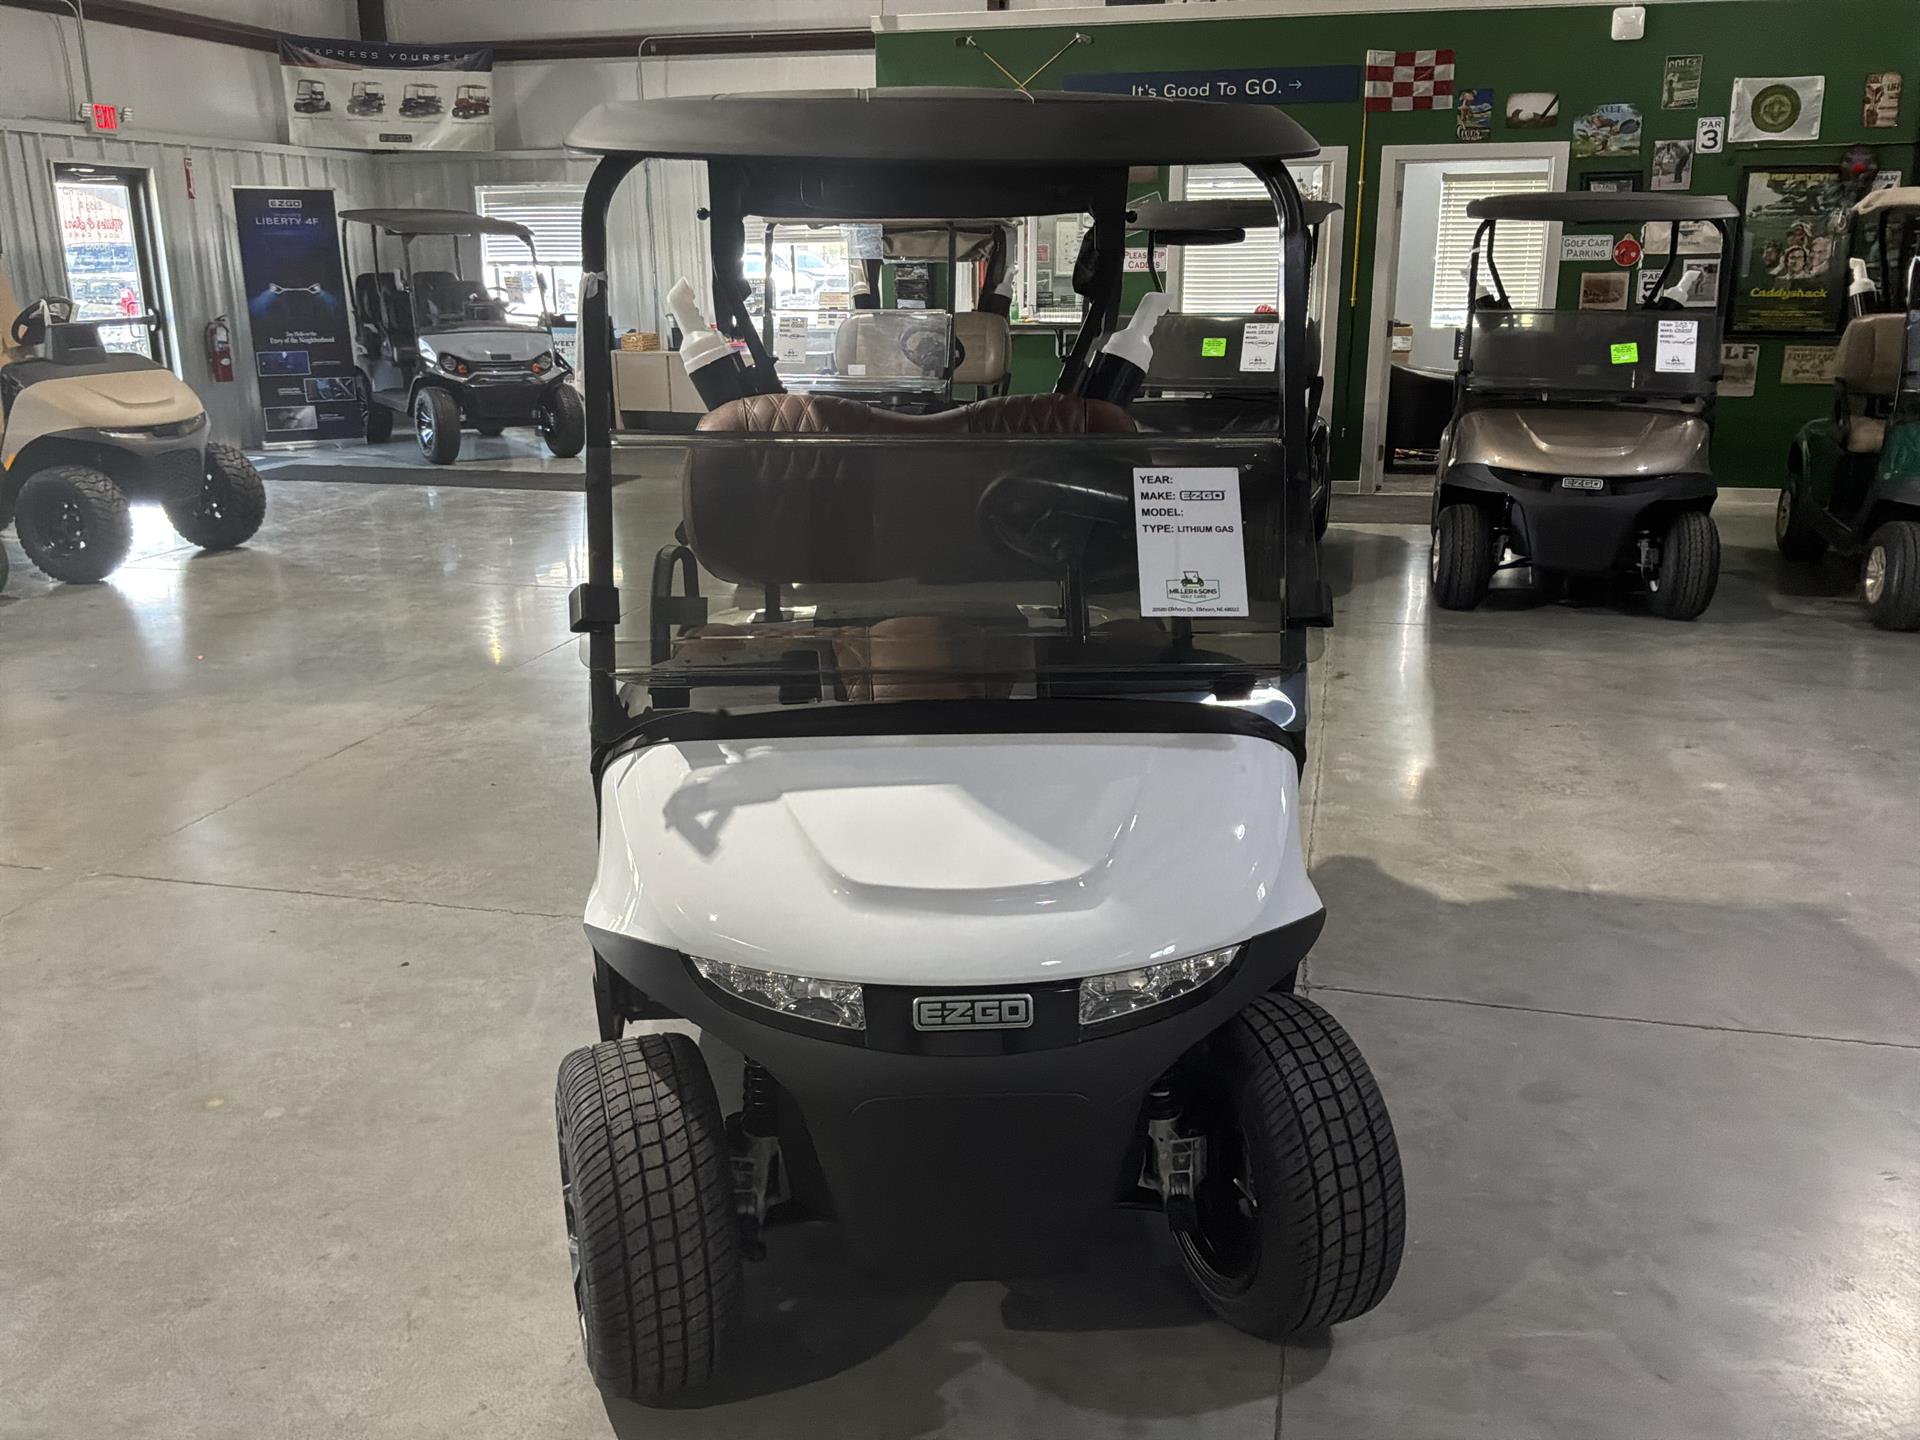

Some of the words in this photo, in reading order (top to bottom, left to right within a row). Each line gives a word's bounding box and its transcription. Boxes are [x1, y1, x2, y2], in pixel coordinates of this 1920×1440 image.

[302, 46, 379, 59] EXPRESS
[389, 53, 472, 61] YOURSELF
[1131, 83, 1157, 97] It's
[1163, 82, 1210, 97] Good
[1217, 82, 1237, 96] To
[1245, 78, 1282, 95] GO.
[93, 103, 117, 129] EXIT
[1701, 129, 1718, 149] 3
[255, 217, 302, 225] LIBERTY
[305, 217, 319, 225] 4F
[1564, 238, 1587, 247] GOLF
[1588, 238, 1611, 247] CART
[1125, 251, 1148, 259] PLEAS
[1566, 250, 1606, 258] PARKING
[1750, 287, 1828, 300] Caddyshack
[1725, 346, 1758, 360] LF
[1140, 475, 1173, 484] YEAR:
[1565, 479, 1601, 488] EZGO
[1140, 492, 1176, 500] MAKE:
[1181, 491, 1224, 500] EZGO
[1141, 508, 1184, 517] MODEL:
[1142, 524, 1174, 533] TYPE:
[918, 999, 1028, 1026] EZGO
